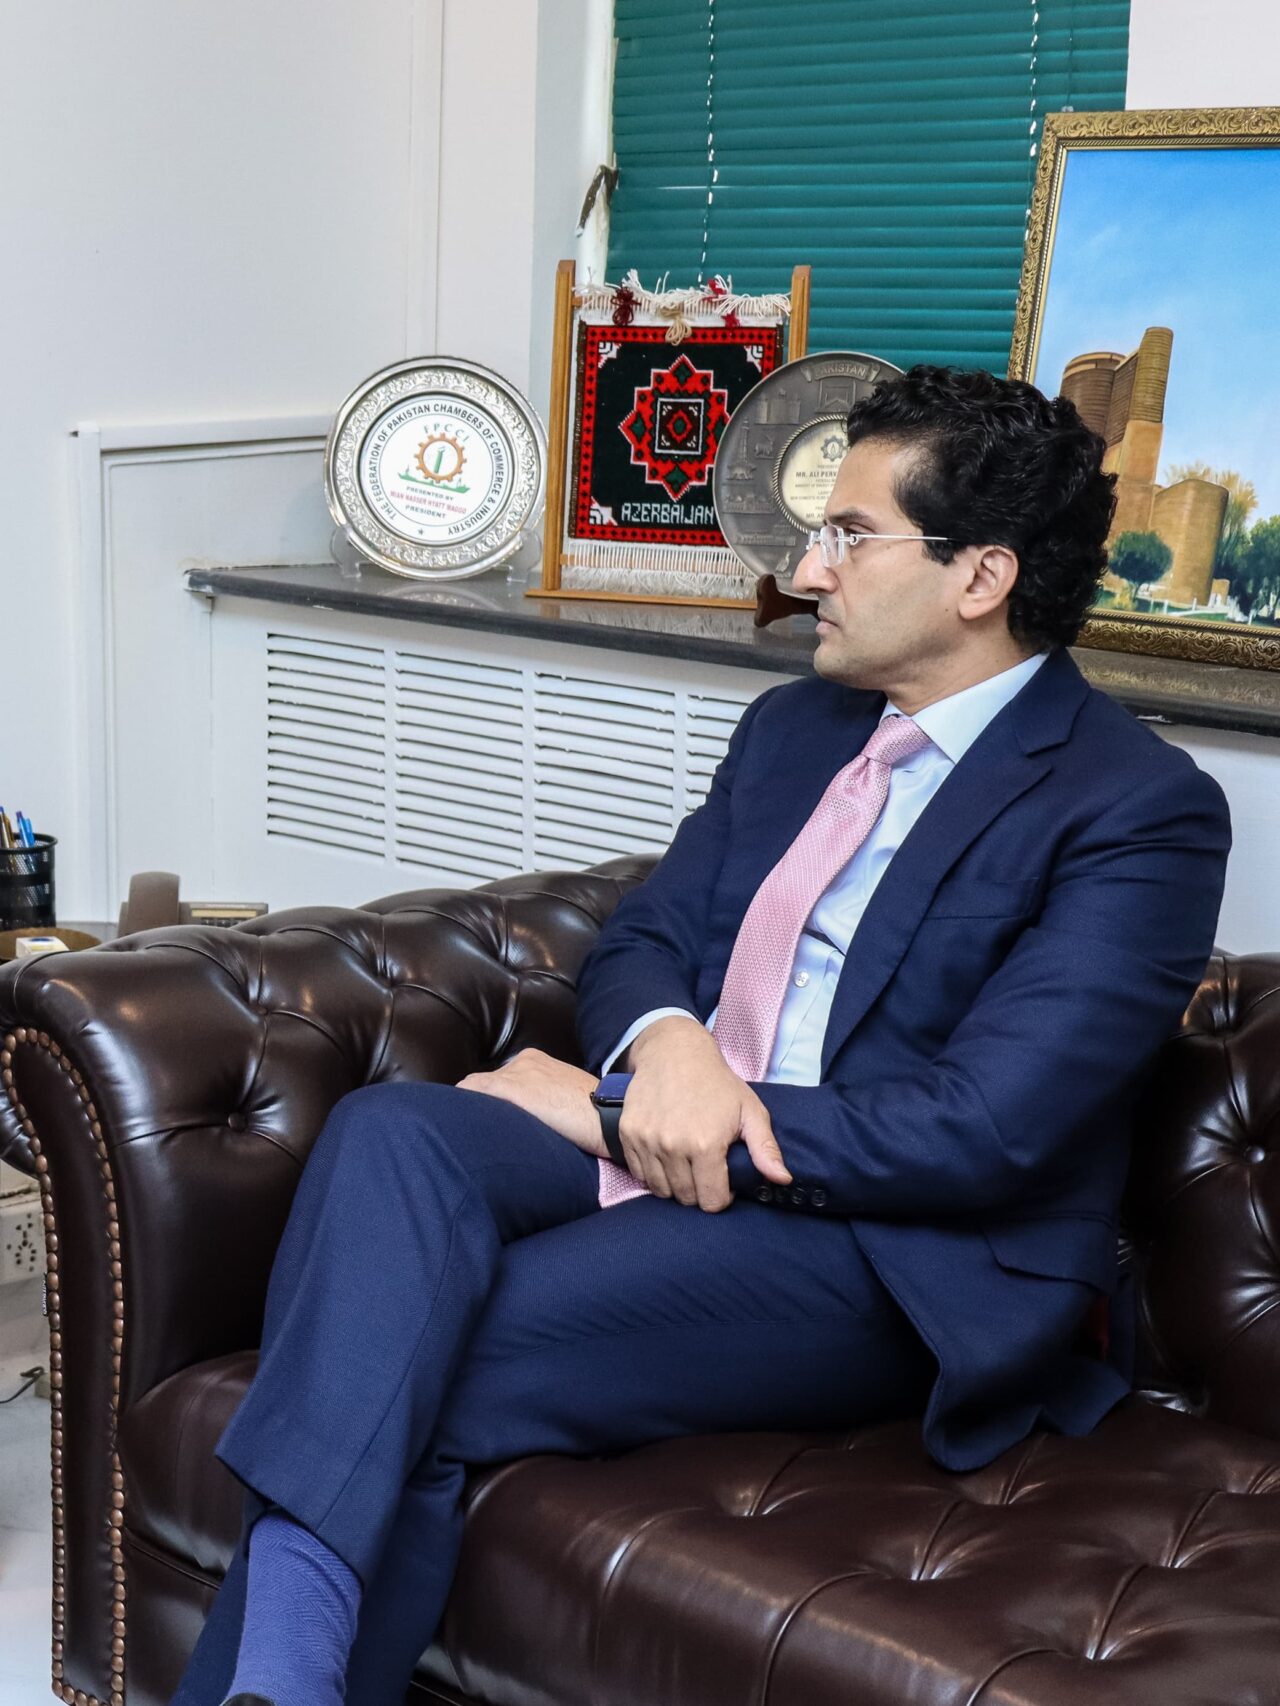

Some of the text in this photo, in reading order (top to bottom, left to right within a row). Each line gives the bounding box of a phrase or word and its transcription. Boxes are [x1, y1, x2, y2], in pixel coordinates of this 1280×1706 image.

[387, 404, 431, 430] PAKISTAN
[434, 403, 483, 430] CHAMBERS
[377, 429, 389, 442] OF
[482, 428, 495, 440] OF
[369, 443, 384, 502] FEDERATION
[490, 441, 504, 496] COMMERCE
[406, 486, 444, 499] PRESENTED
[381, 502, 397, 520] THE
[405, 504, 447, 519] PRESIDENT
[448, 505, 491, 535] INDUSTRY
[621, 502, 714, 525] AZERBAIJAN
